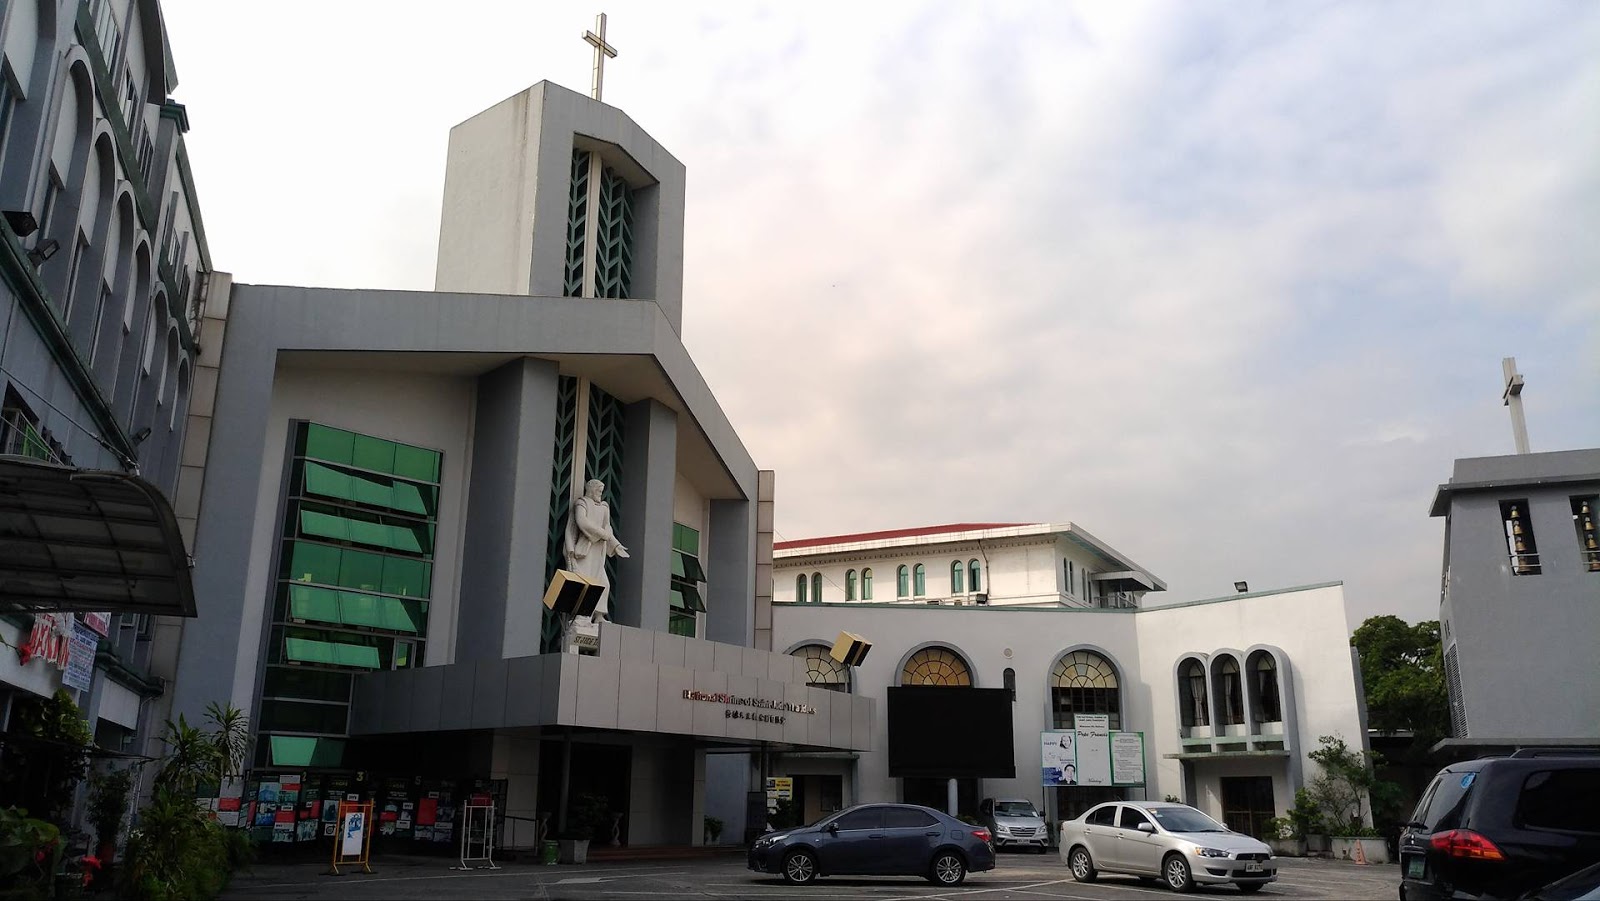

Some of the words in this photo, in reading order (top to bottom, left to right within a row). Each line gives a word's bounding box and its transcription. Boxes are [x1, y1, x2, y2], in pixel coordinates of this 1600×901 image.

[683, 690, 718, 702] National
[718, 693, 744, 705] Shrine
[744, 697, 752, 706] of
[356, 771, 364, 782] 3
